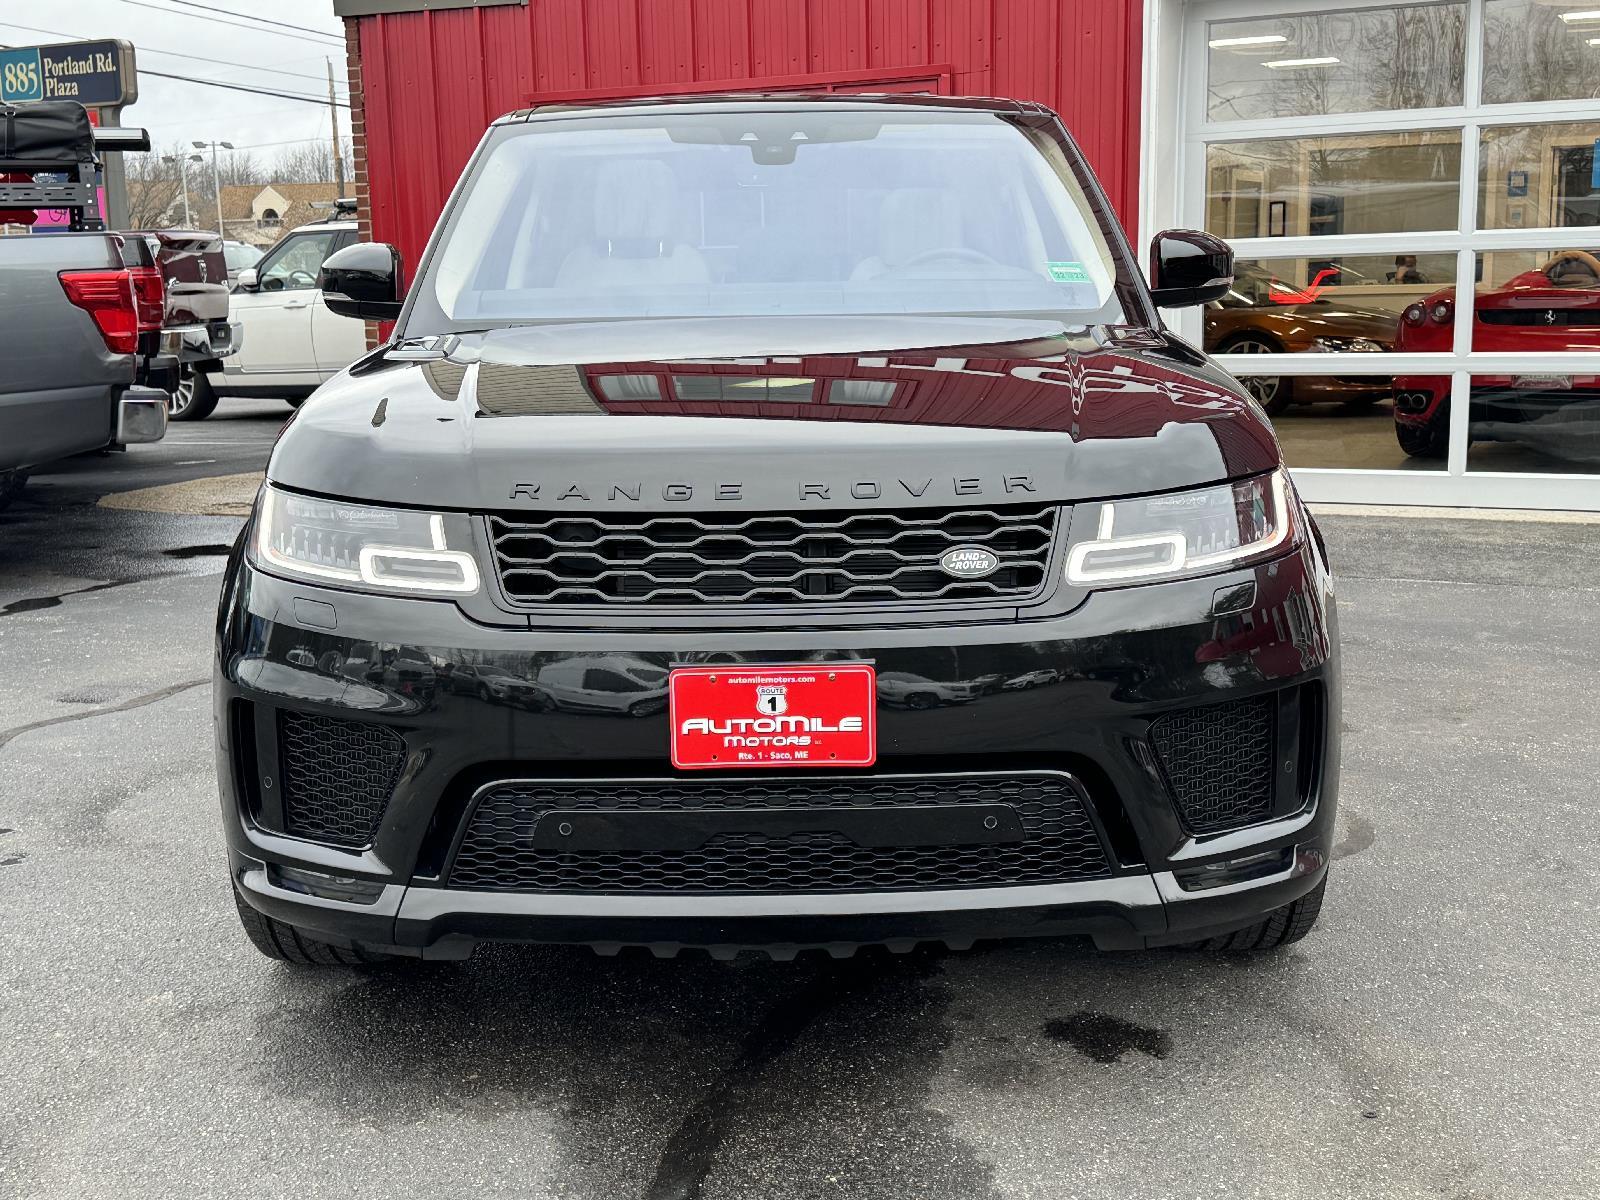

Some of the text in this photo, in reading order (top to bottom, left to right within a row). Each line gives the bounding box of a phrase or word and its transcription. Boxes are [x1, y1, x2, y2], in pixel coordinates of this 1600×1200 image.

[43, 52, 117, 77] Portland Rd.
[4, 62, 38, 95] 885
[45, 77, 79, 97] Plaza
[508, 473, 1037, 501] RANGE ROVER
[952, 552, 980, 562] LAND
[954, 560, 989, 570] ROVER
[728, 675, 816, 684] automilemotors.com
[767, 696, 777, 712] 1
[681, 715, 863, 736] AUTOMILE
[723, 735, 812, 748] MOTORS
[738, 752, 756, 760] Rte.
[758, 752, 763, 760] 1
[770, 751, 793, 760] Saco,
[795, 750, 809, 759] ME
